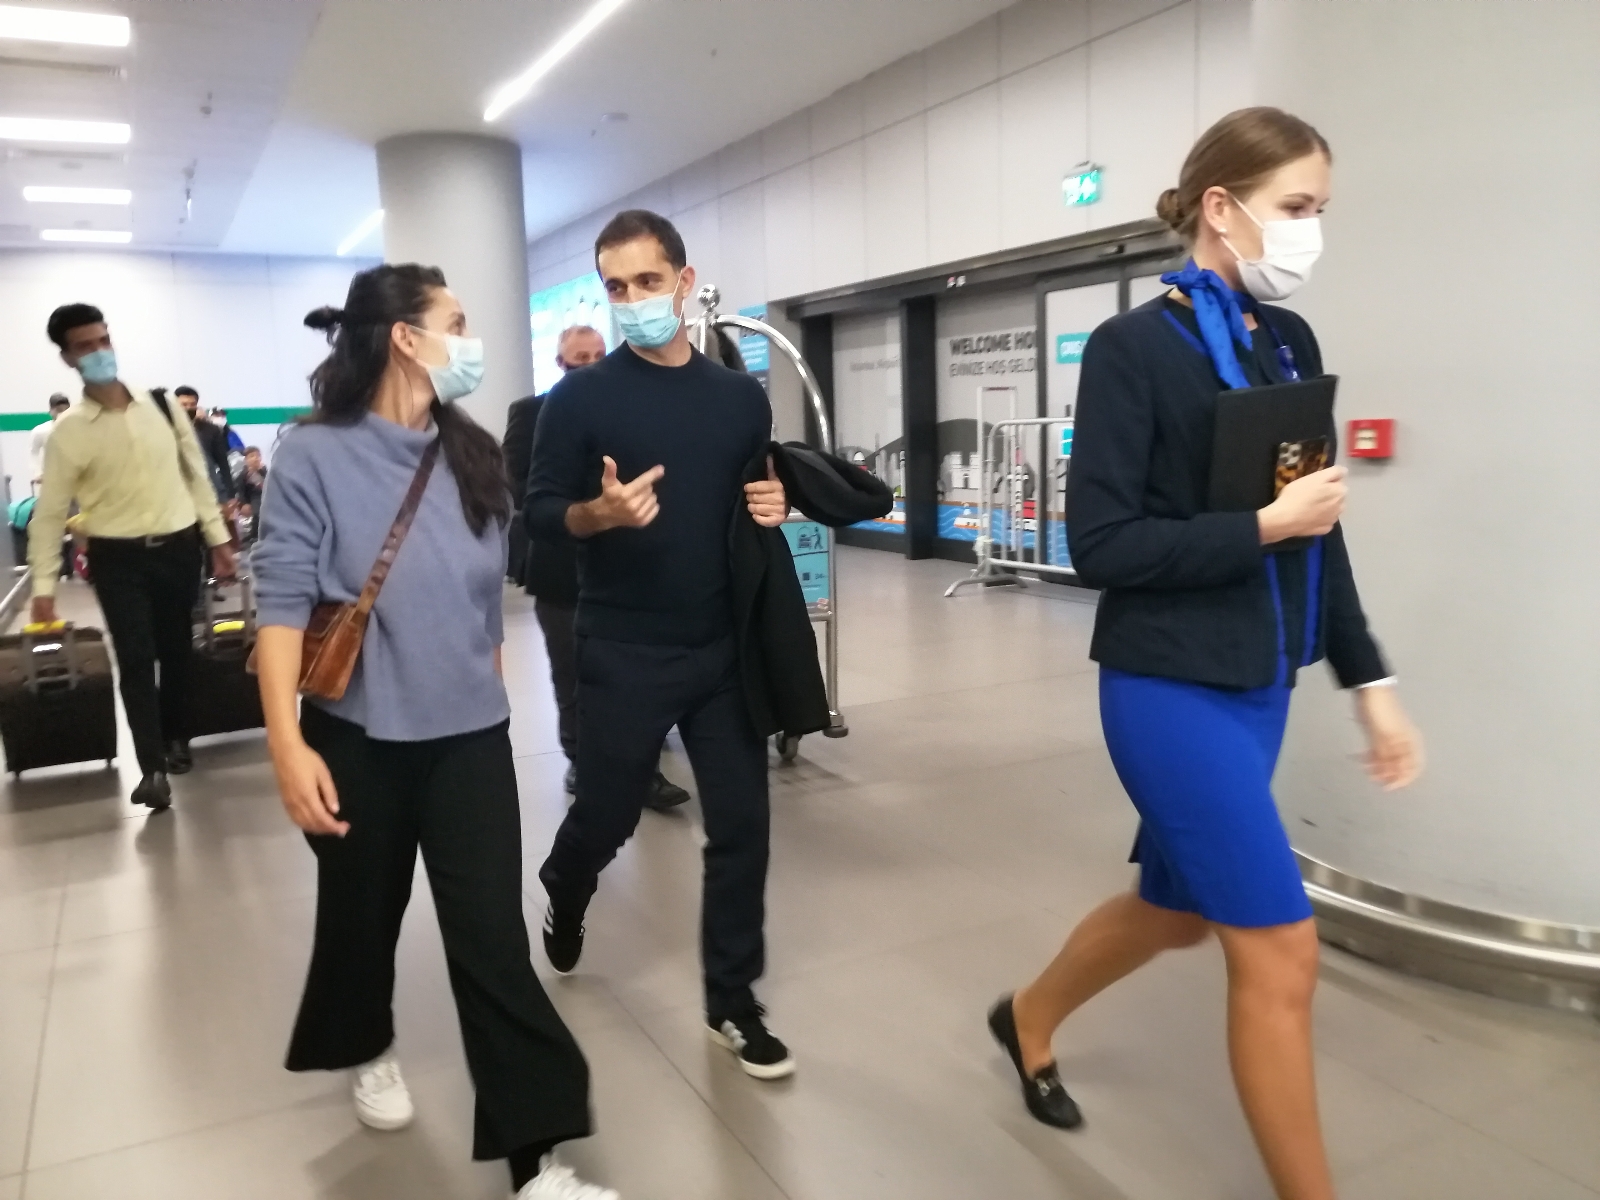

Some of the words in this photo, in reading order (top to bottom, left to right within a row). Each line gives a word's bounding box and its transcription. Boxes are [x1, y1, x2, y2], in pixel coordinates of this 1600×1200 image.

[950, 333, 1011, 355] WELCOME
[1014, 330, 1038, 350] HO
[985, 359, 1007, 375] HOŞ
